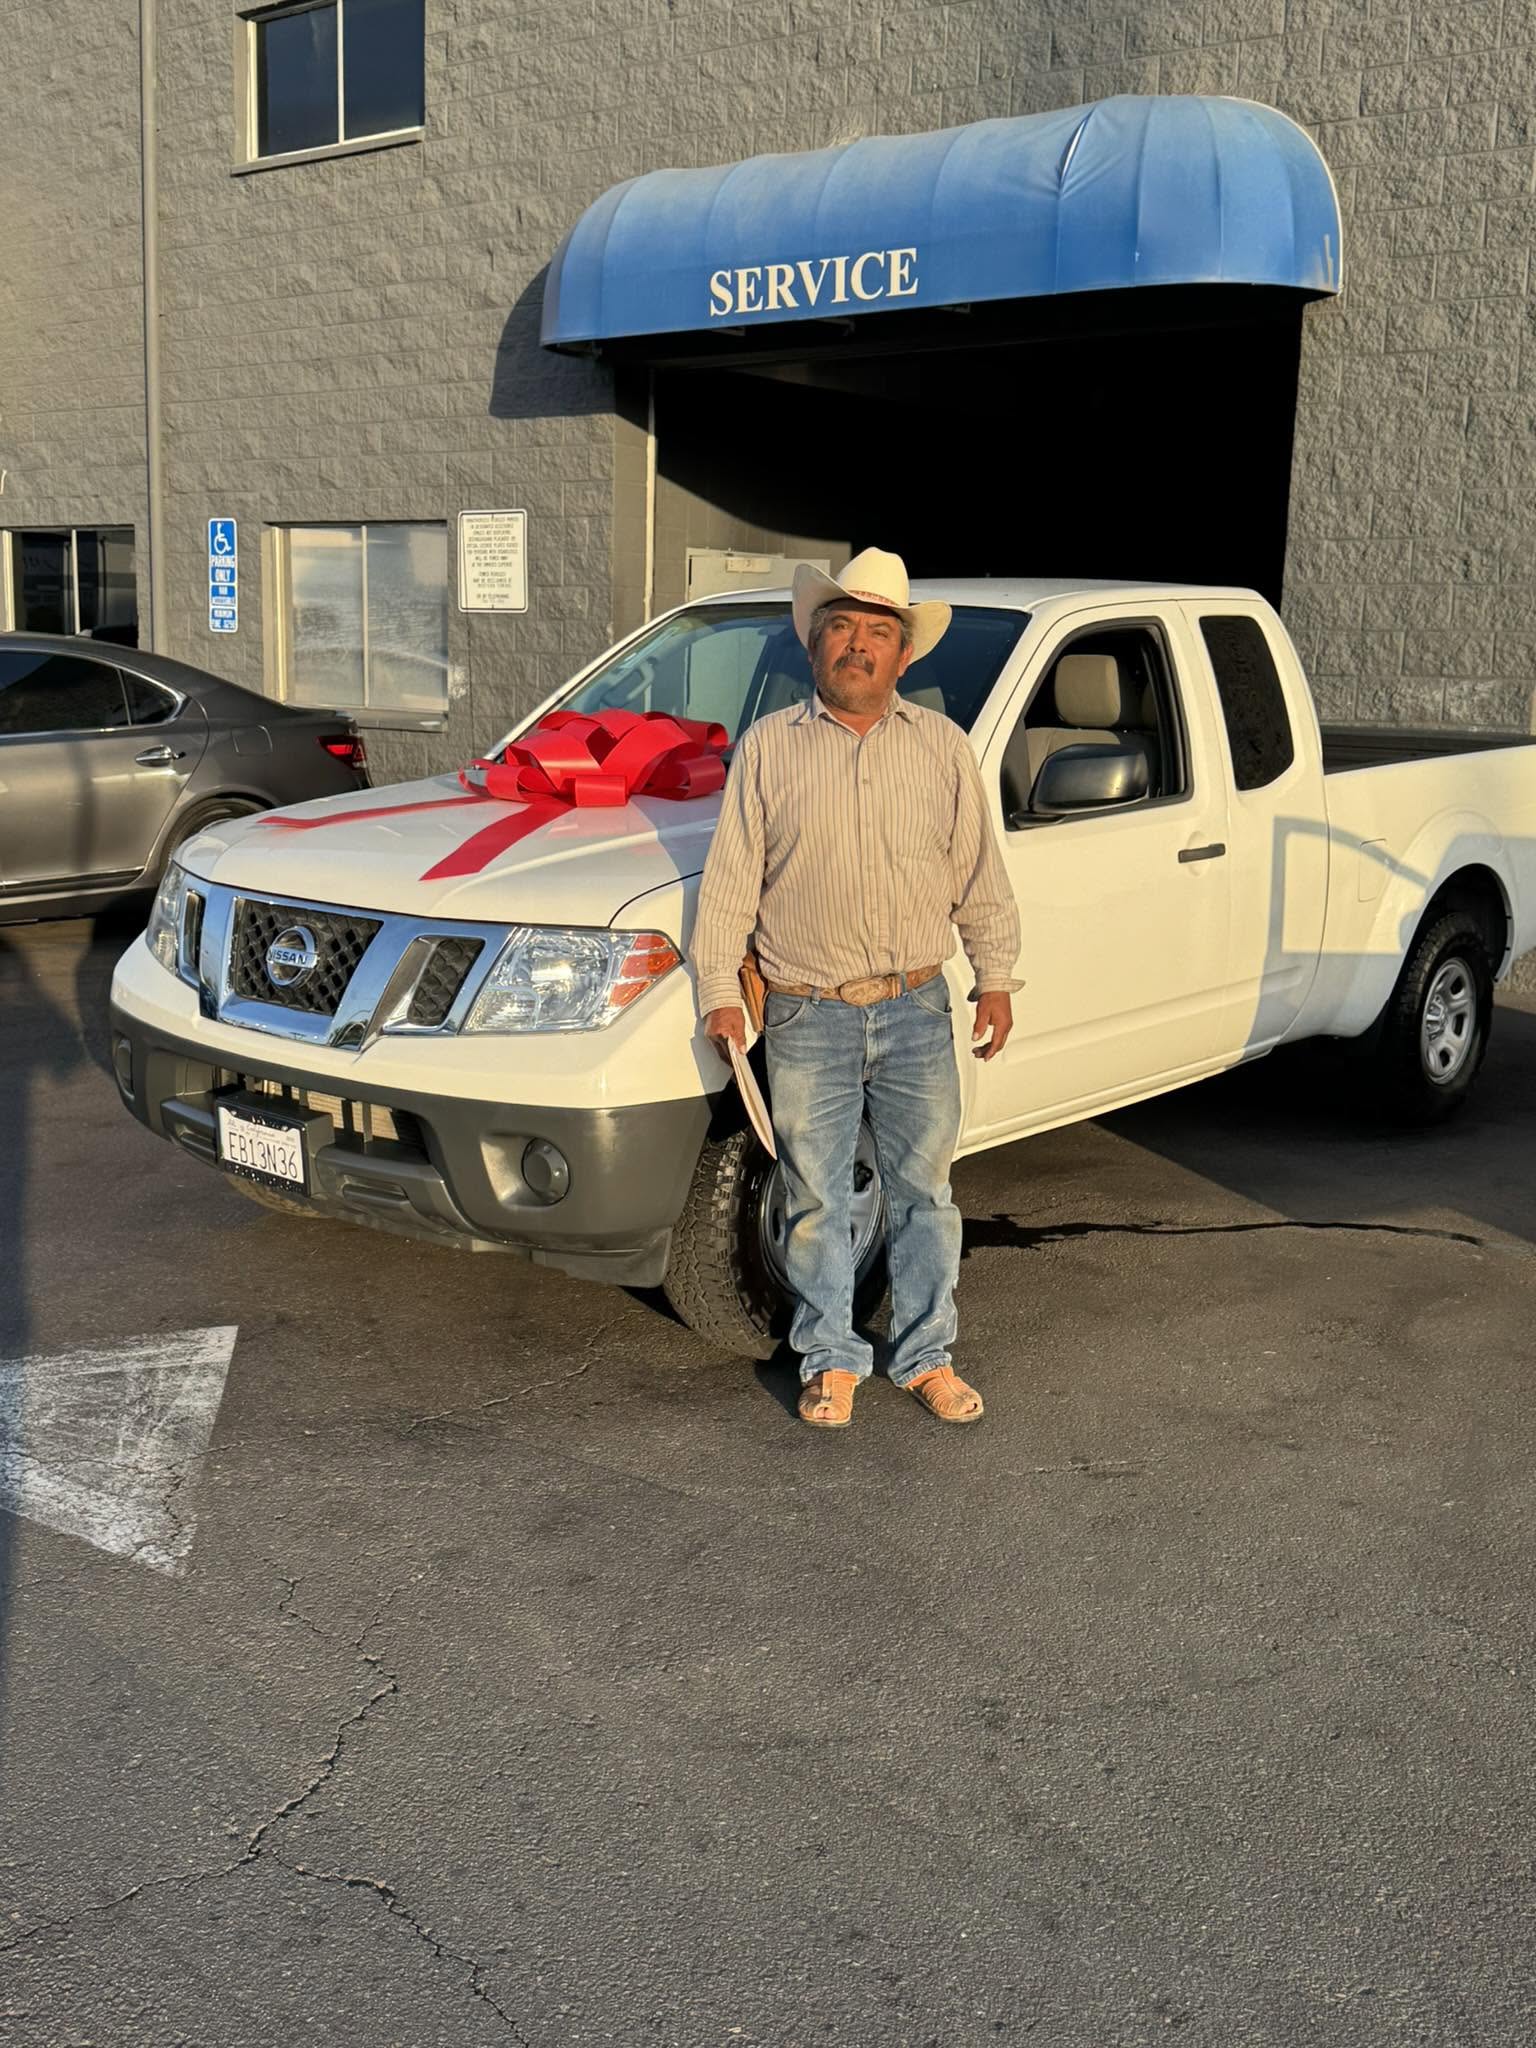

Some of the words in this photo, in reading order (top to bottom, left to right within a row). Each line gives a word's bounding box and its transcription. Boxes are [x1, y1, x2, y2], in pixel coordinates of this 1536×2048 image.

[710, 248, 919, 316] SERVICE
[268, 949, 308, 965] NISSAN
[228, 1131, 298, 1179] EB13N36
